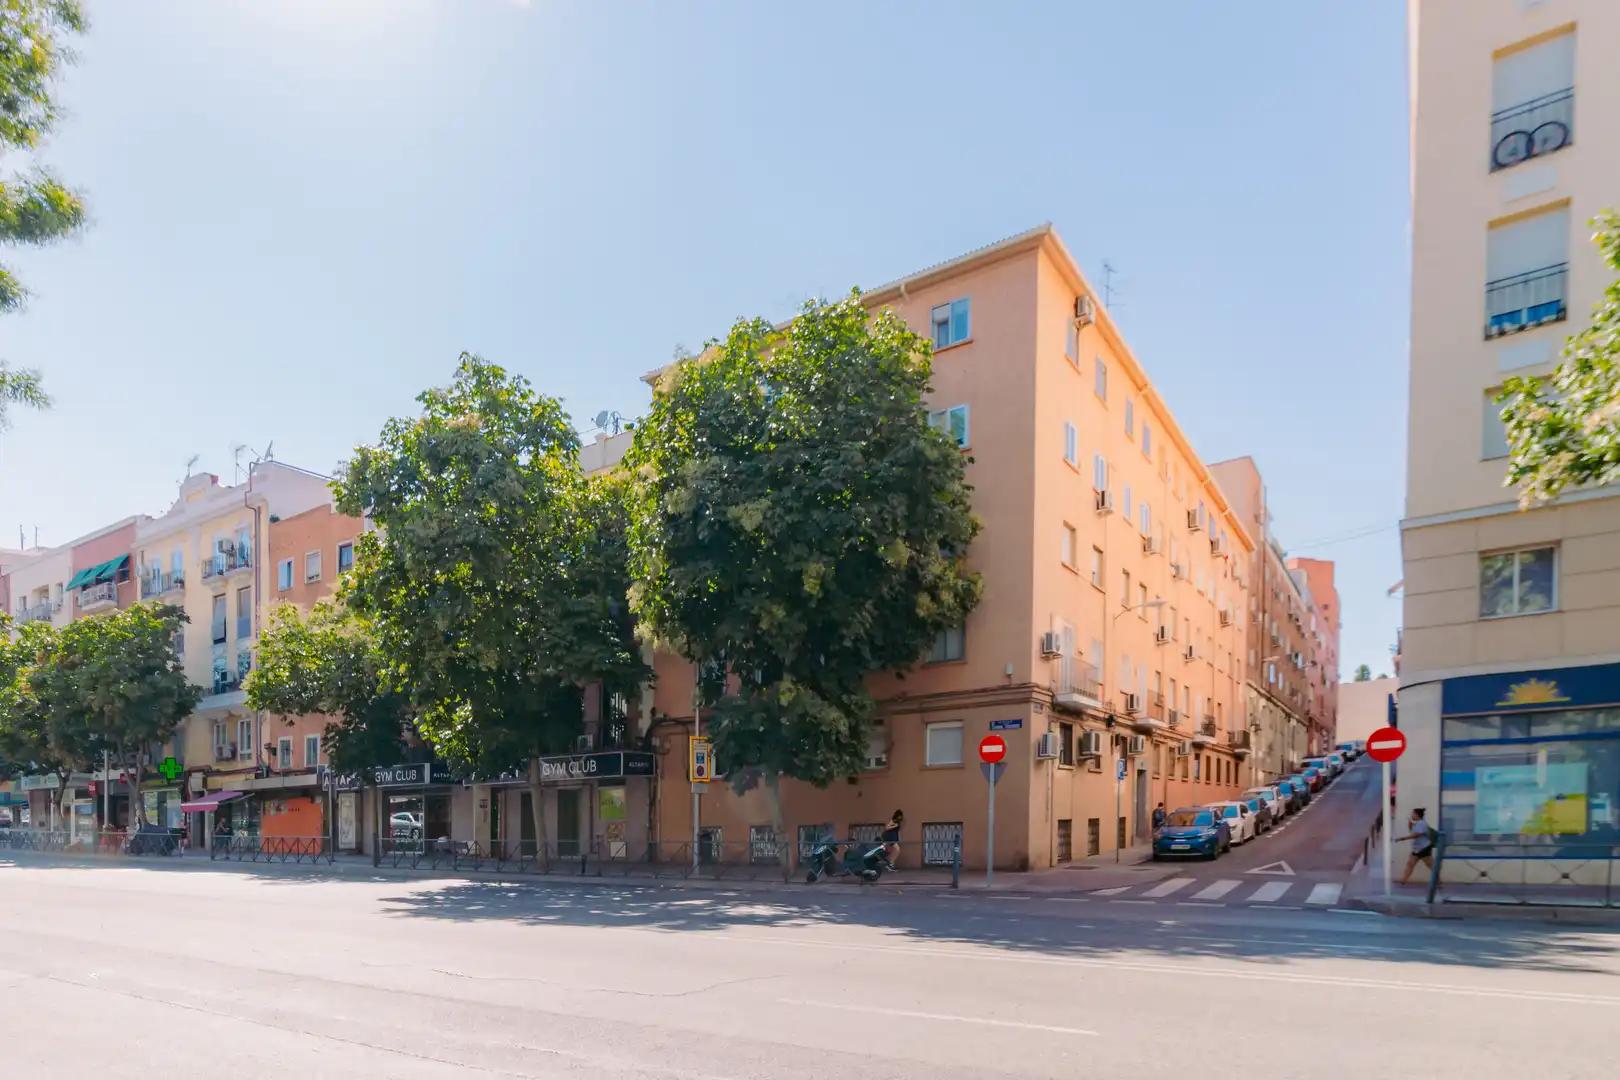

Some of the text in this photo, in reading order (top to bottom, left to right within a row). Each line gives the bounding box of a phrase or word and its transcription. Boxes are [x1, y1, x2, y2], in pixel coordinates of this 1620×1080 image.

[542, 760, 597, 775] GYM CLUB
[375, 771, 393, 782] GYM
[395, 769, 417, 781] CLUB
